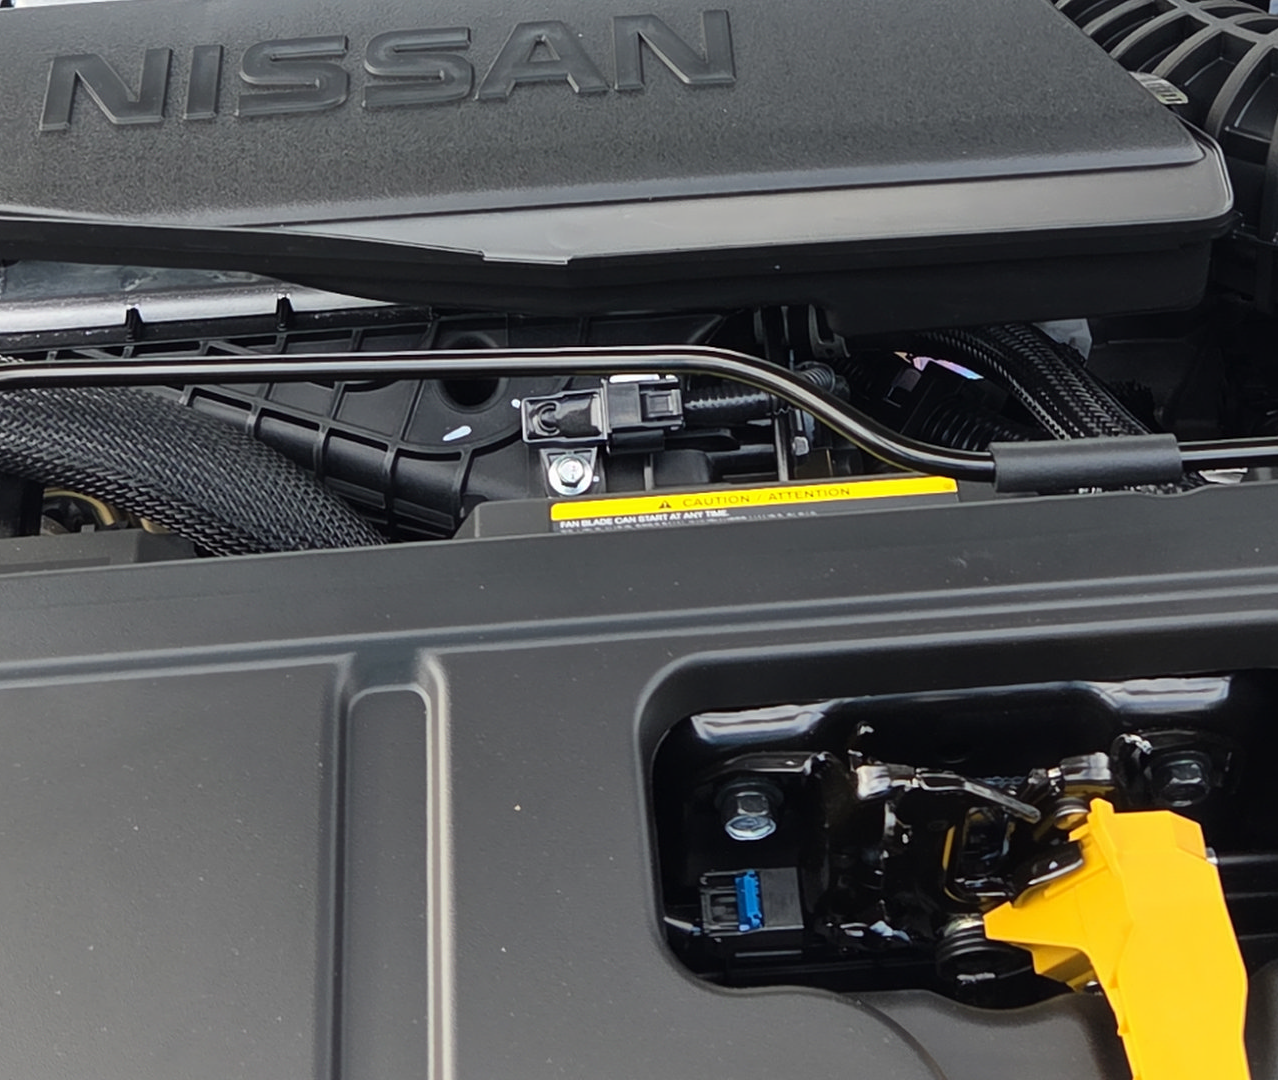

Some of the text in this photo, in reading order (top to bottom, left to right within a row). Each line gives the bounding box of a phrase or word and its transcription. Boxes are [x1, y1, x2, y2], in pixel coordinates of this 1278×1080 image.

[39, 9, 737, 132] NISSAN
[682, 494, 751, 508] CAUTION
[768, 488, 851, 502] ATTENTION
[560, 520, 580, 529] FAN
[581, 518, 613, 528] BLADE
[614, 515, 637, 525] CAN
[638, 513, 668, 523] START
[669, 512, 683, 521] AT
[683, 510, 704, 520] ANY
